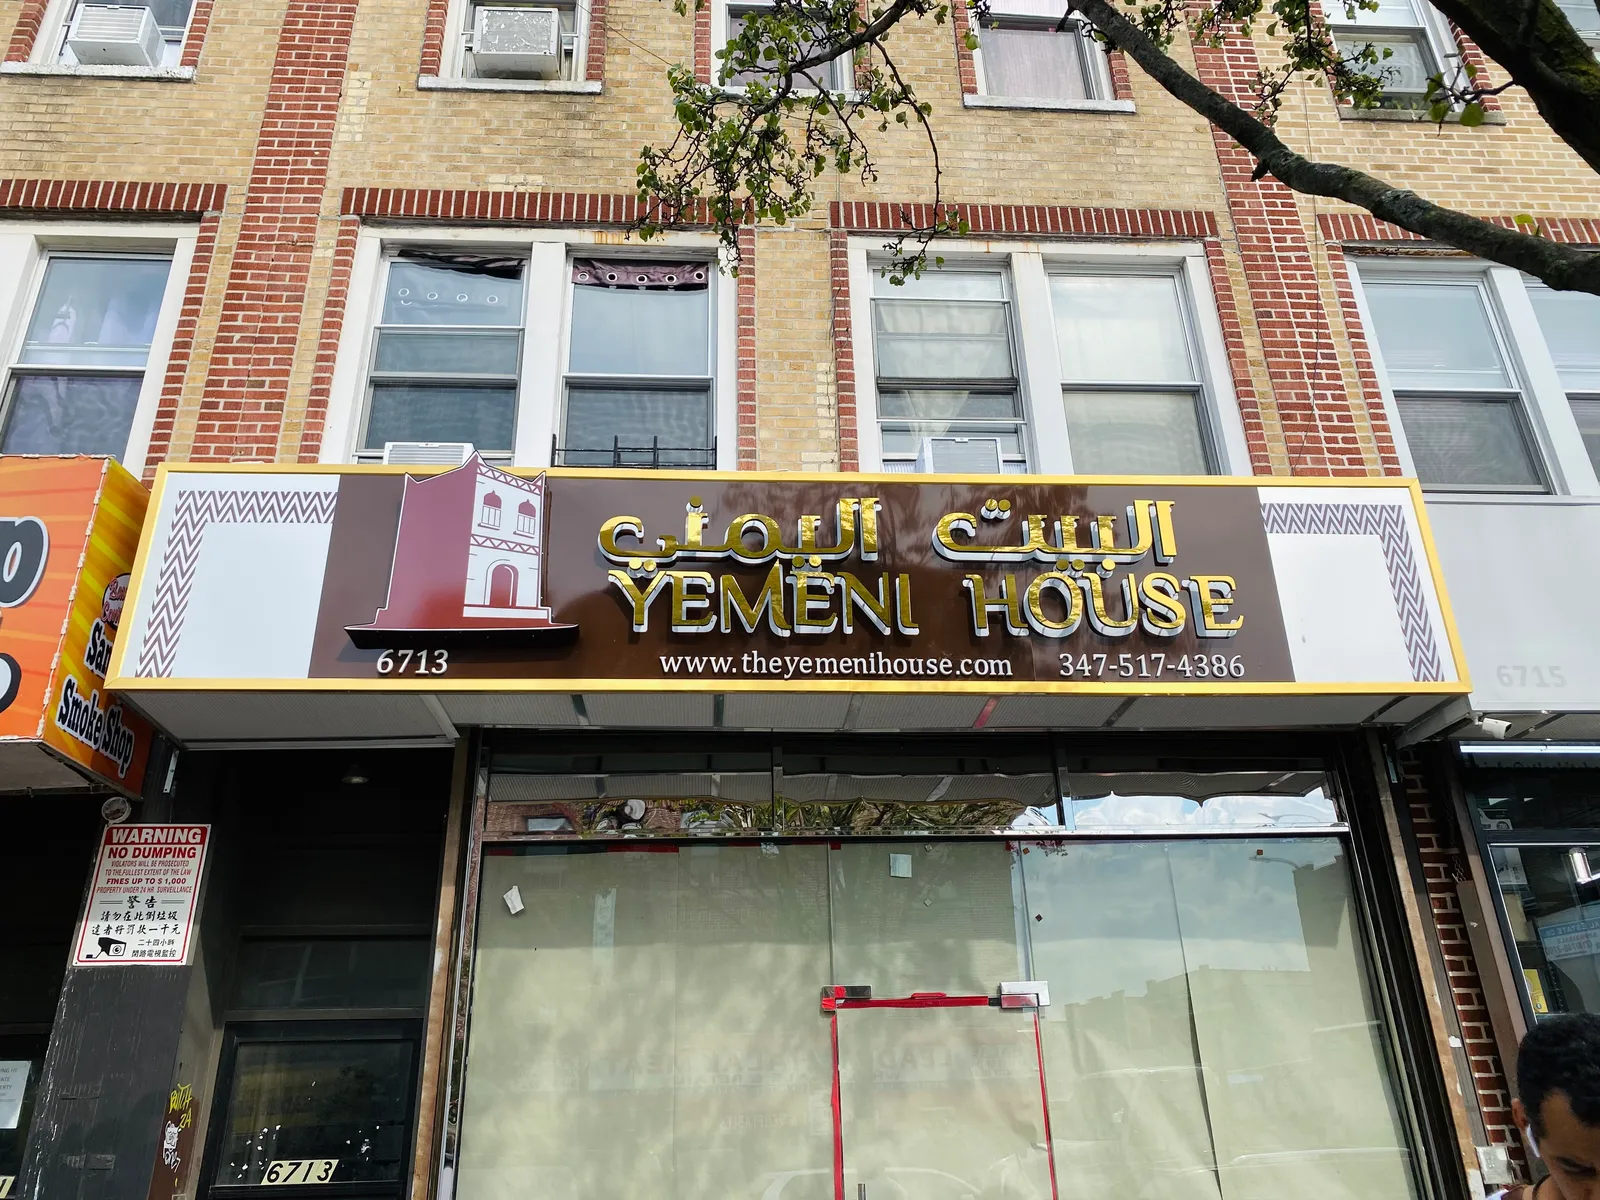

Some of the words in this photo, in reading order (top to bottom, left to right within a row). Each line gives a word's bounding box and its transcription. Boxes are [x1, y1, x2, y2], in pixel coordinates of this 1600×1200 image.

[599, 496, 882, 576] اليمني
[932, 498, 1177, 576] البيت
[608, 562, 919, 636] YEMENI
[963, 571, 1245, 638] HOUSE
[376, 649, 449, 675] 6713
[660, 650, 1013, 679] www.theyemenihouse.com
[1059, 653, 1245, 678] 347-517-4386
[1496, 664, 1568, 688] 6715
[57, 676, 102, 748] Smoke
[101, 707, 134, 776] Shop
[112, 828, 201, 843] WARNING
[108, 847, 128, 858] NO
[132, 847, 197, 859] DUMPING
[127, 895, 157, 909] 警告
[267, 1161, 333, 1183] 6713
